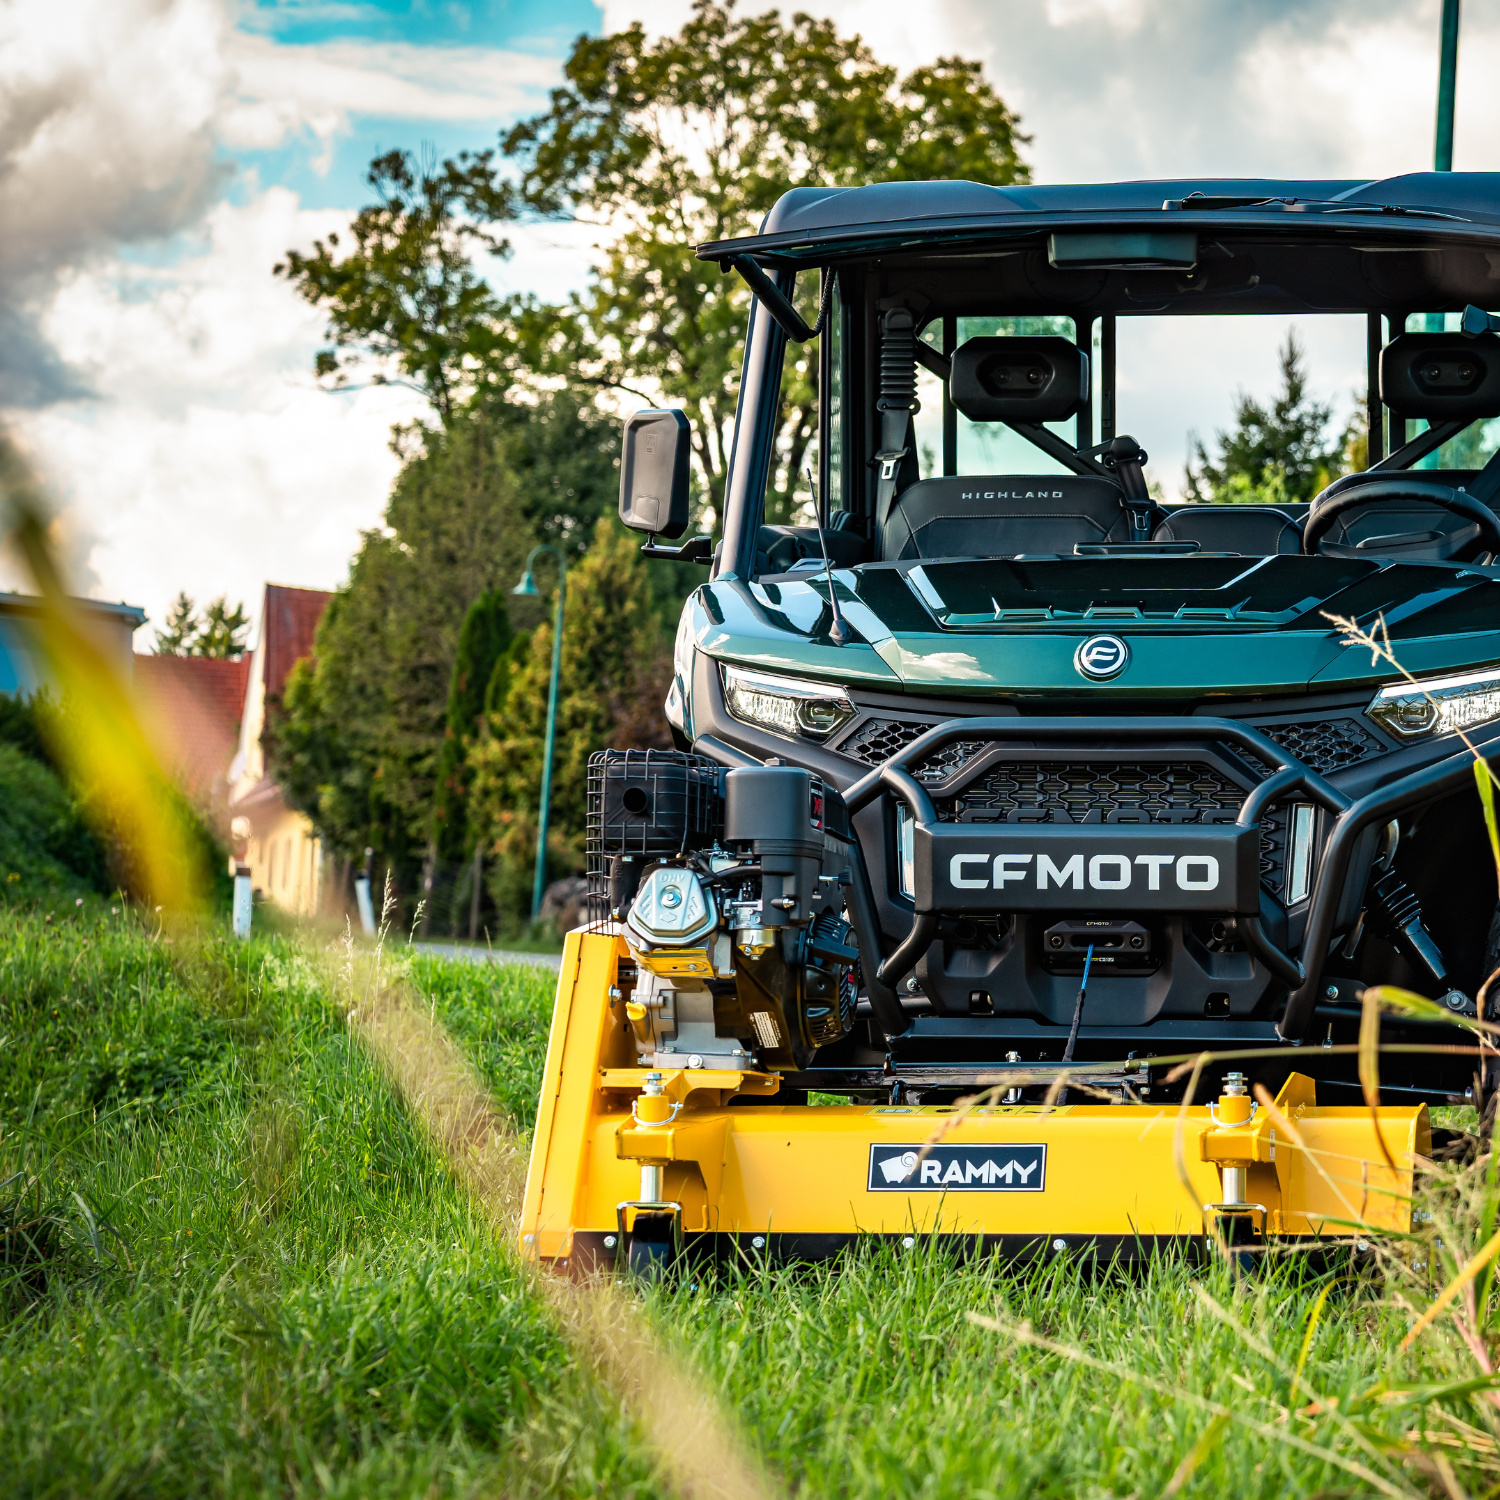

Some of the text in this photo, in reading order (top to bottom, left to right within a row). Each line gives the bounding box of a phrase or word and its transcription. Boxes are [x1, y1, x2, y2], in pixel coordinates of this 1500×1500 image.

[961, 491, 1063, 500] HIGHLAND
[661, 873, 685, 883] OHV
[950, 853, 1219, 891] CFMOTO
[920, 1159, 1038, 1184] RAMMY
